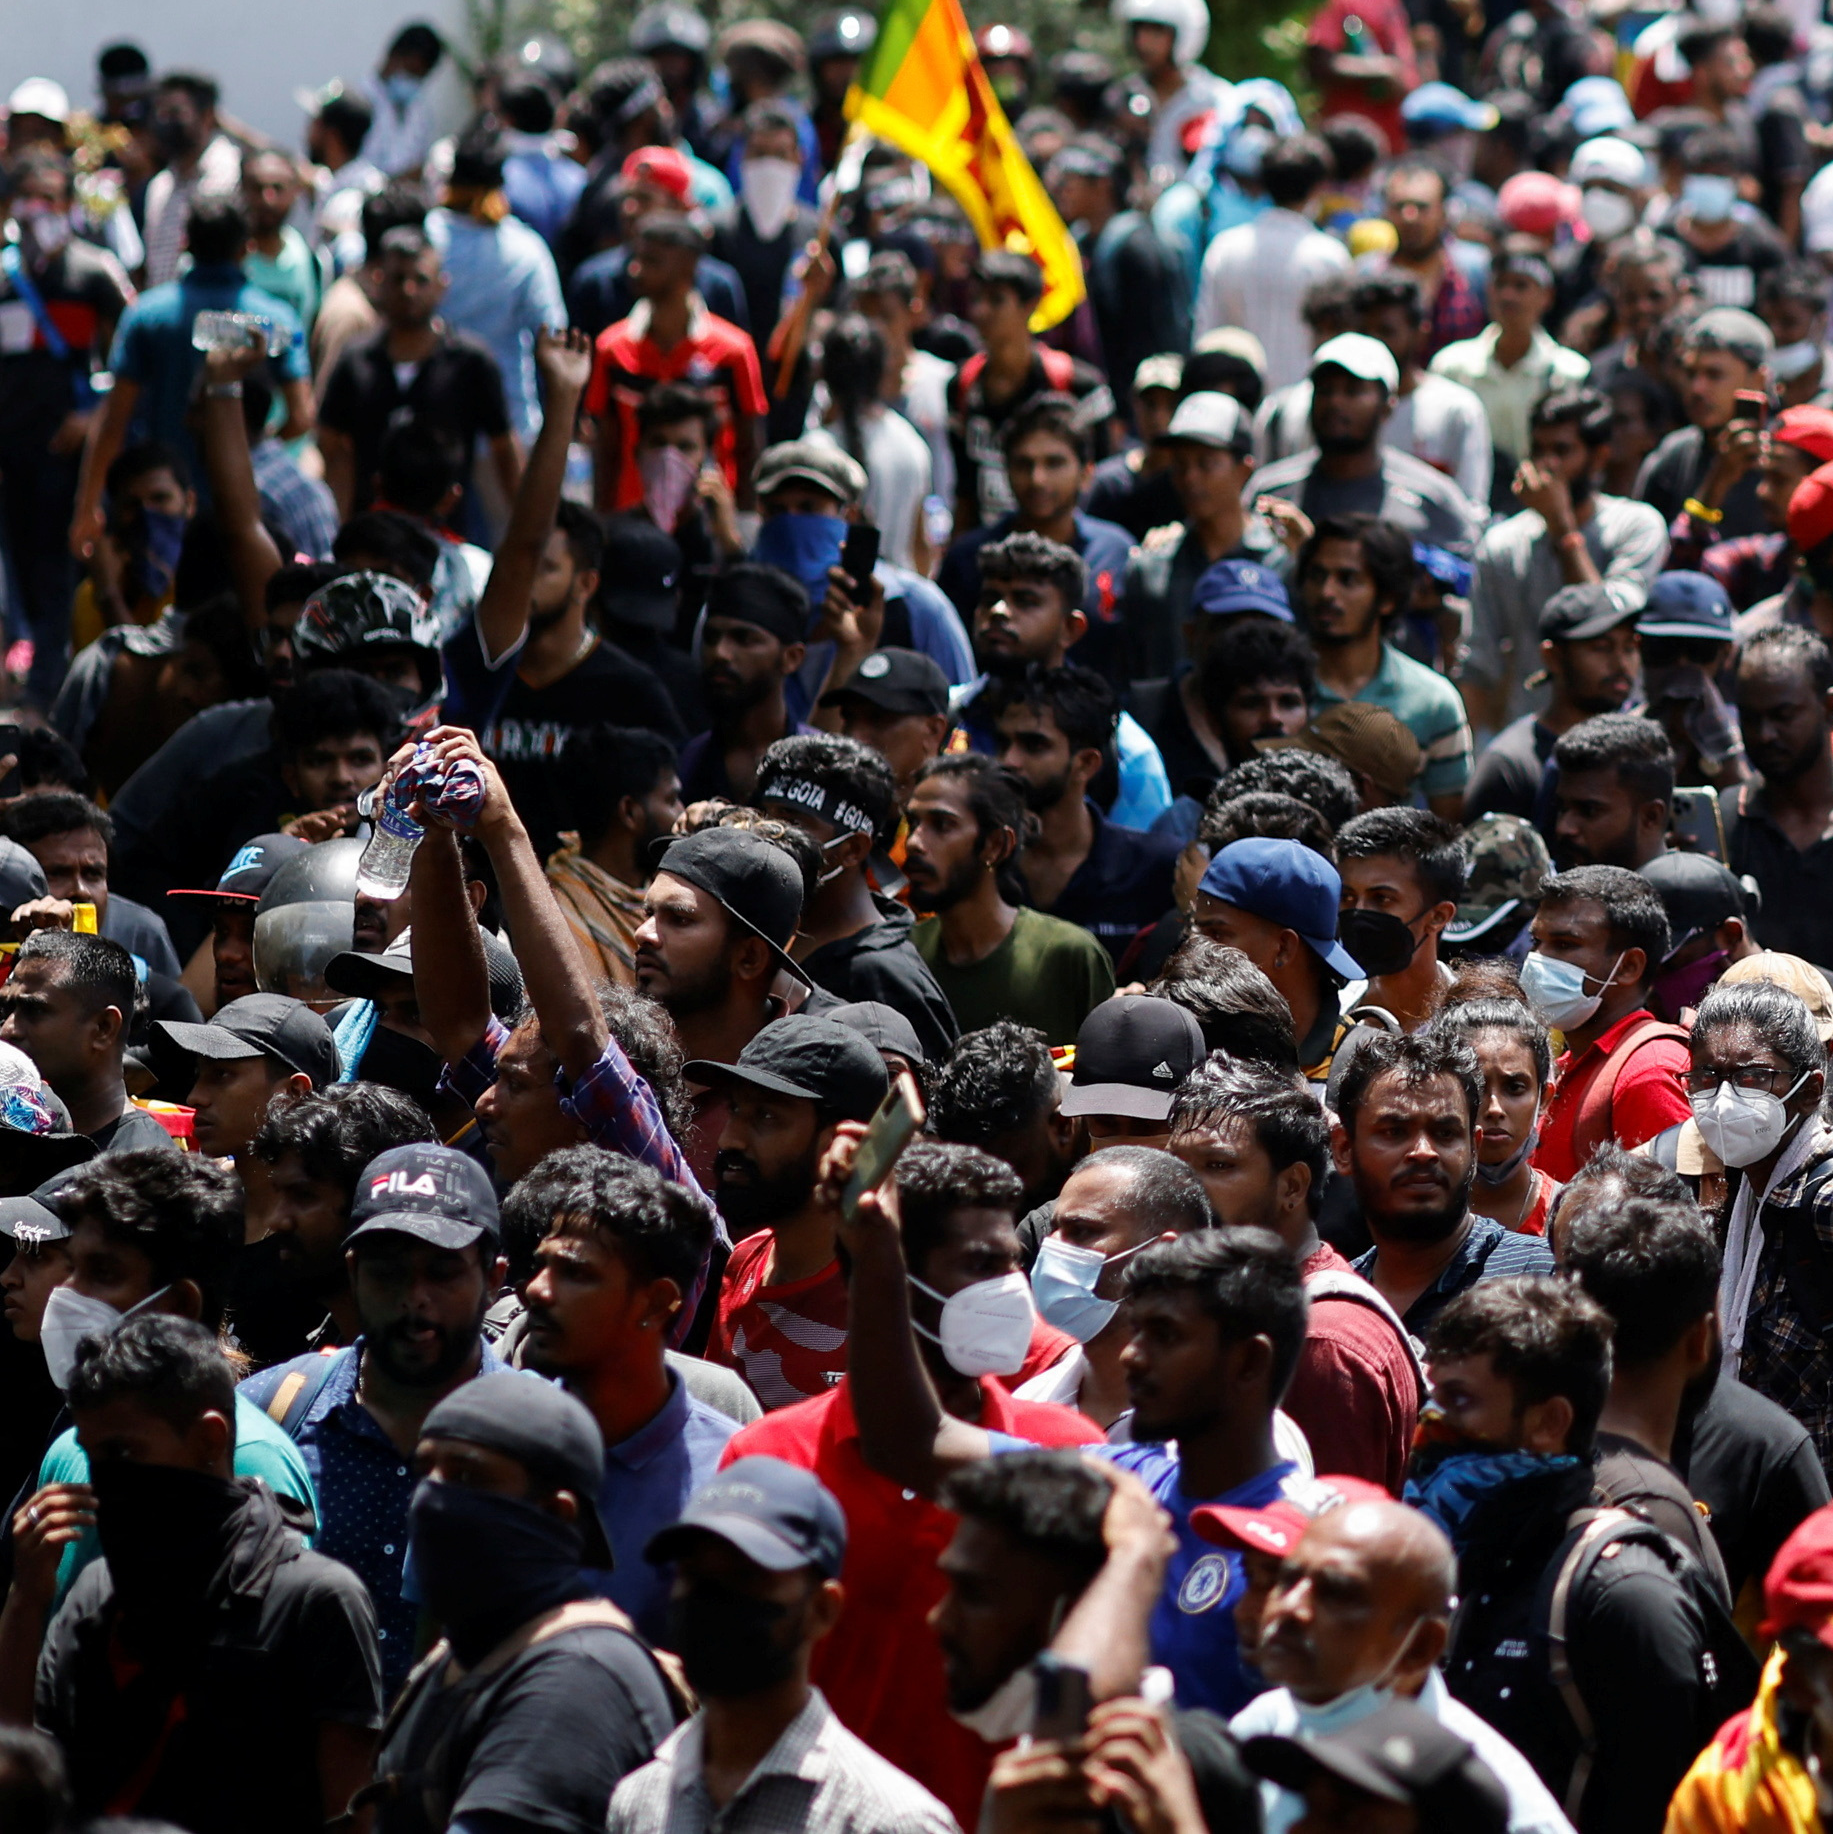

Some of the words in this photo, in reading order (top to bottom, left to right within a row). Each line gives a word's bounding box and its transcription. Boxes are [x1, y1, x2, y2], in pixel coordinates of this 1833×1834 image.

[787, 779, 827, 811] GOTA
[371, 1170, 437, 1200] FILA
[14, 1221, 52, 1235] Jordan
